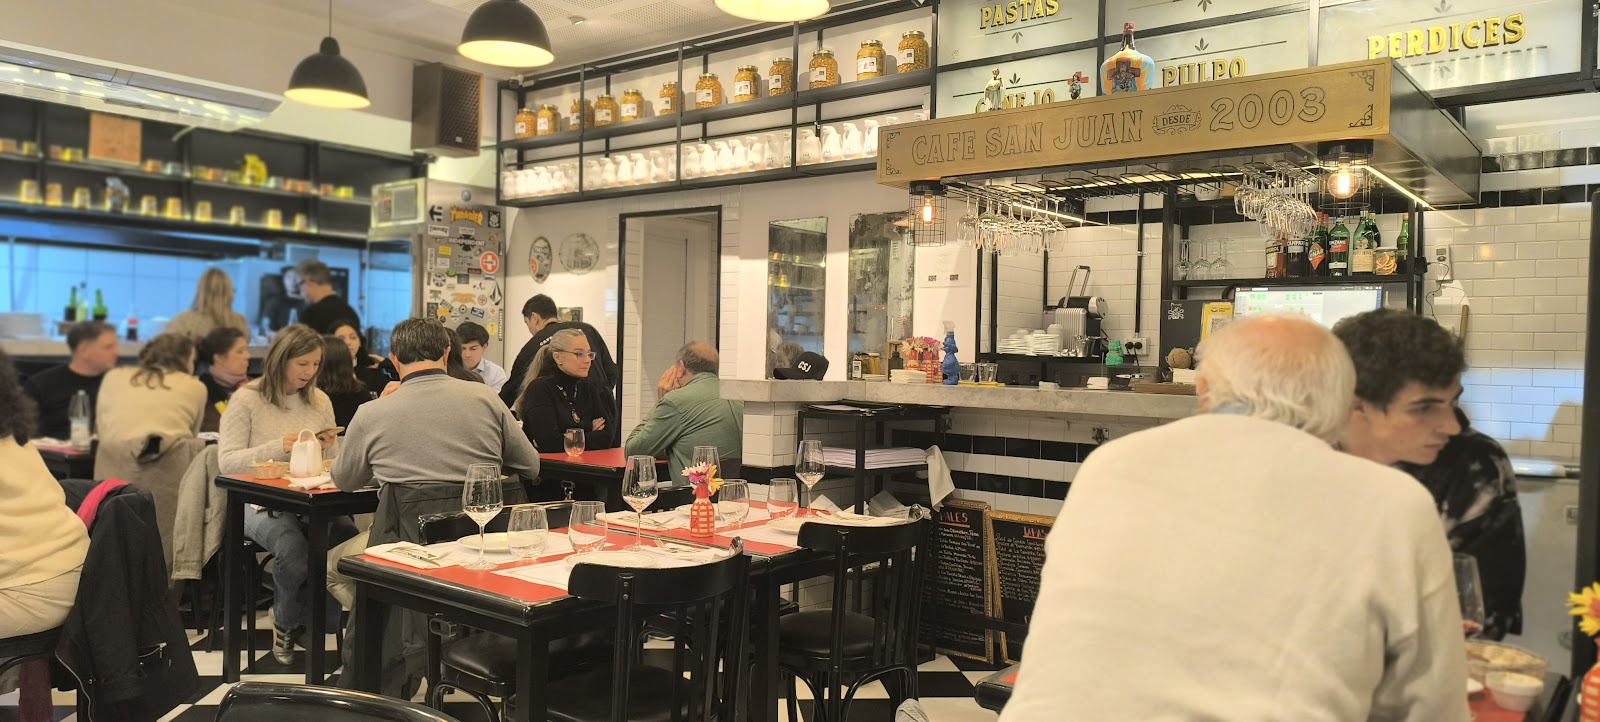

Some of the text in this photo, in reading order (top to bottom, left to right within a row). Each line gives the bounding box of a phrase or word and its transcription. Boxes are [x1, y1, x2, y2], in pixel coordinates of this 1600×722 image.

[979, 0, 1061, 30] PASTAS
[1367, 13, 1527, 60] PERDICES
[1161, 55, 1247, 88] PULPO
[975, 88, 1055, 113] CNEJO
[911, 86, 1327, 165] CAFE SAN JUAN DESDE 2003
[798, 361, 811, 372] CSJ
